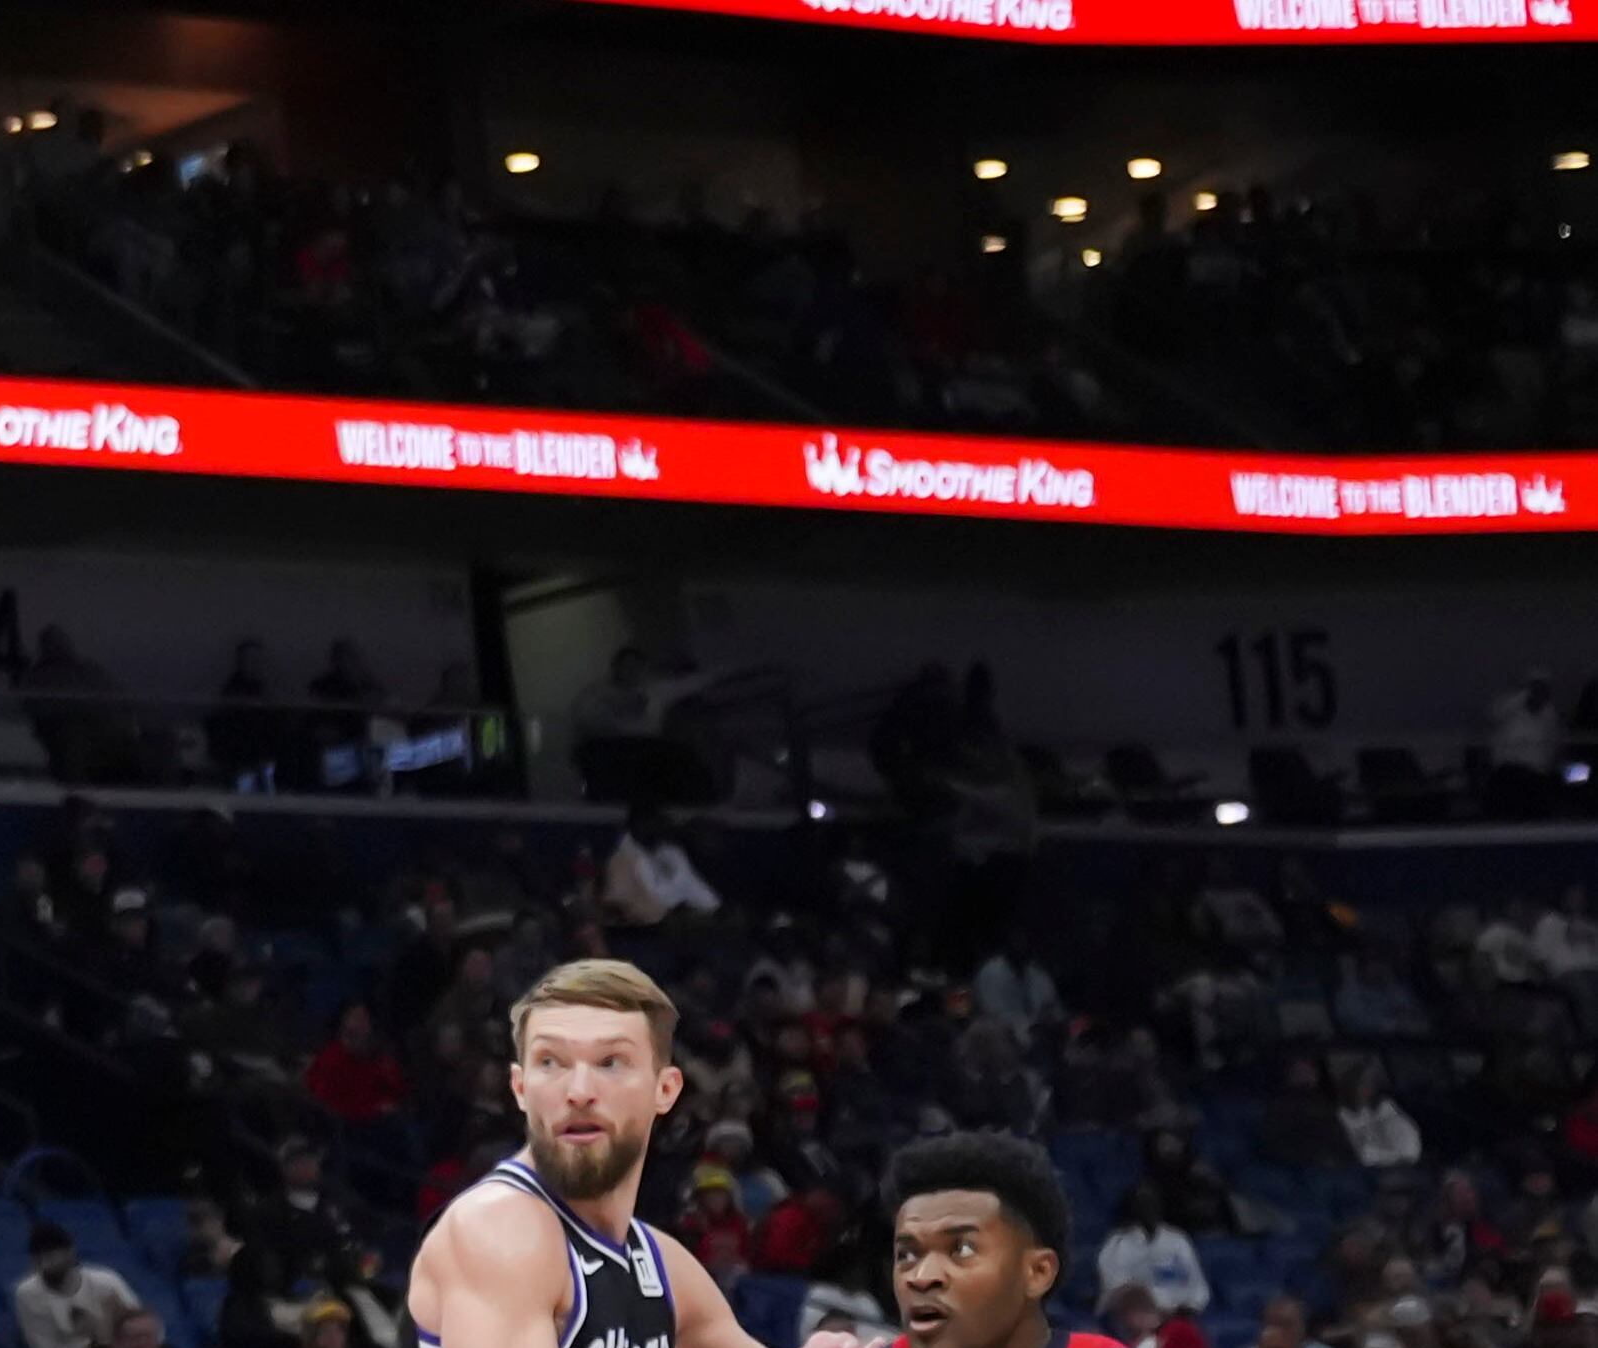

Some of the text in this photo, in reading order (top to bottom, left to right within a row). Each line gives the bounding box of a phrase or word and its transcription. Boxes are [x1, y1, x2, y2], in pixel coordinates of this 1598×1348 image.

[92, 402, 180, 456] KING
[335, 420, 616, 479] WELCOME TO THE BLENDER
[865, 448, 1095, 508] SMOOTHIE KING
[1230, 471, 1341, 520] WELCOME
[1403, 472, 1518, 519] BLENDER
[1214, 627, 1339, 730] 115
